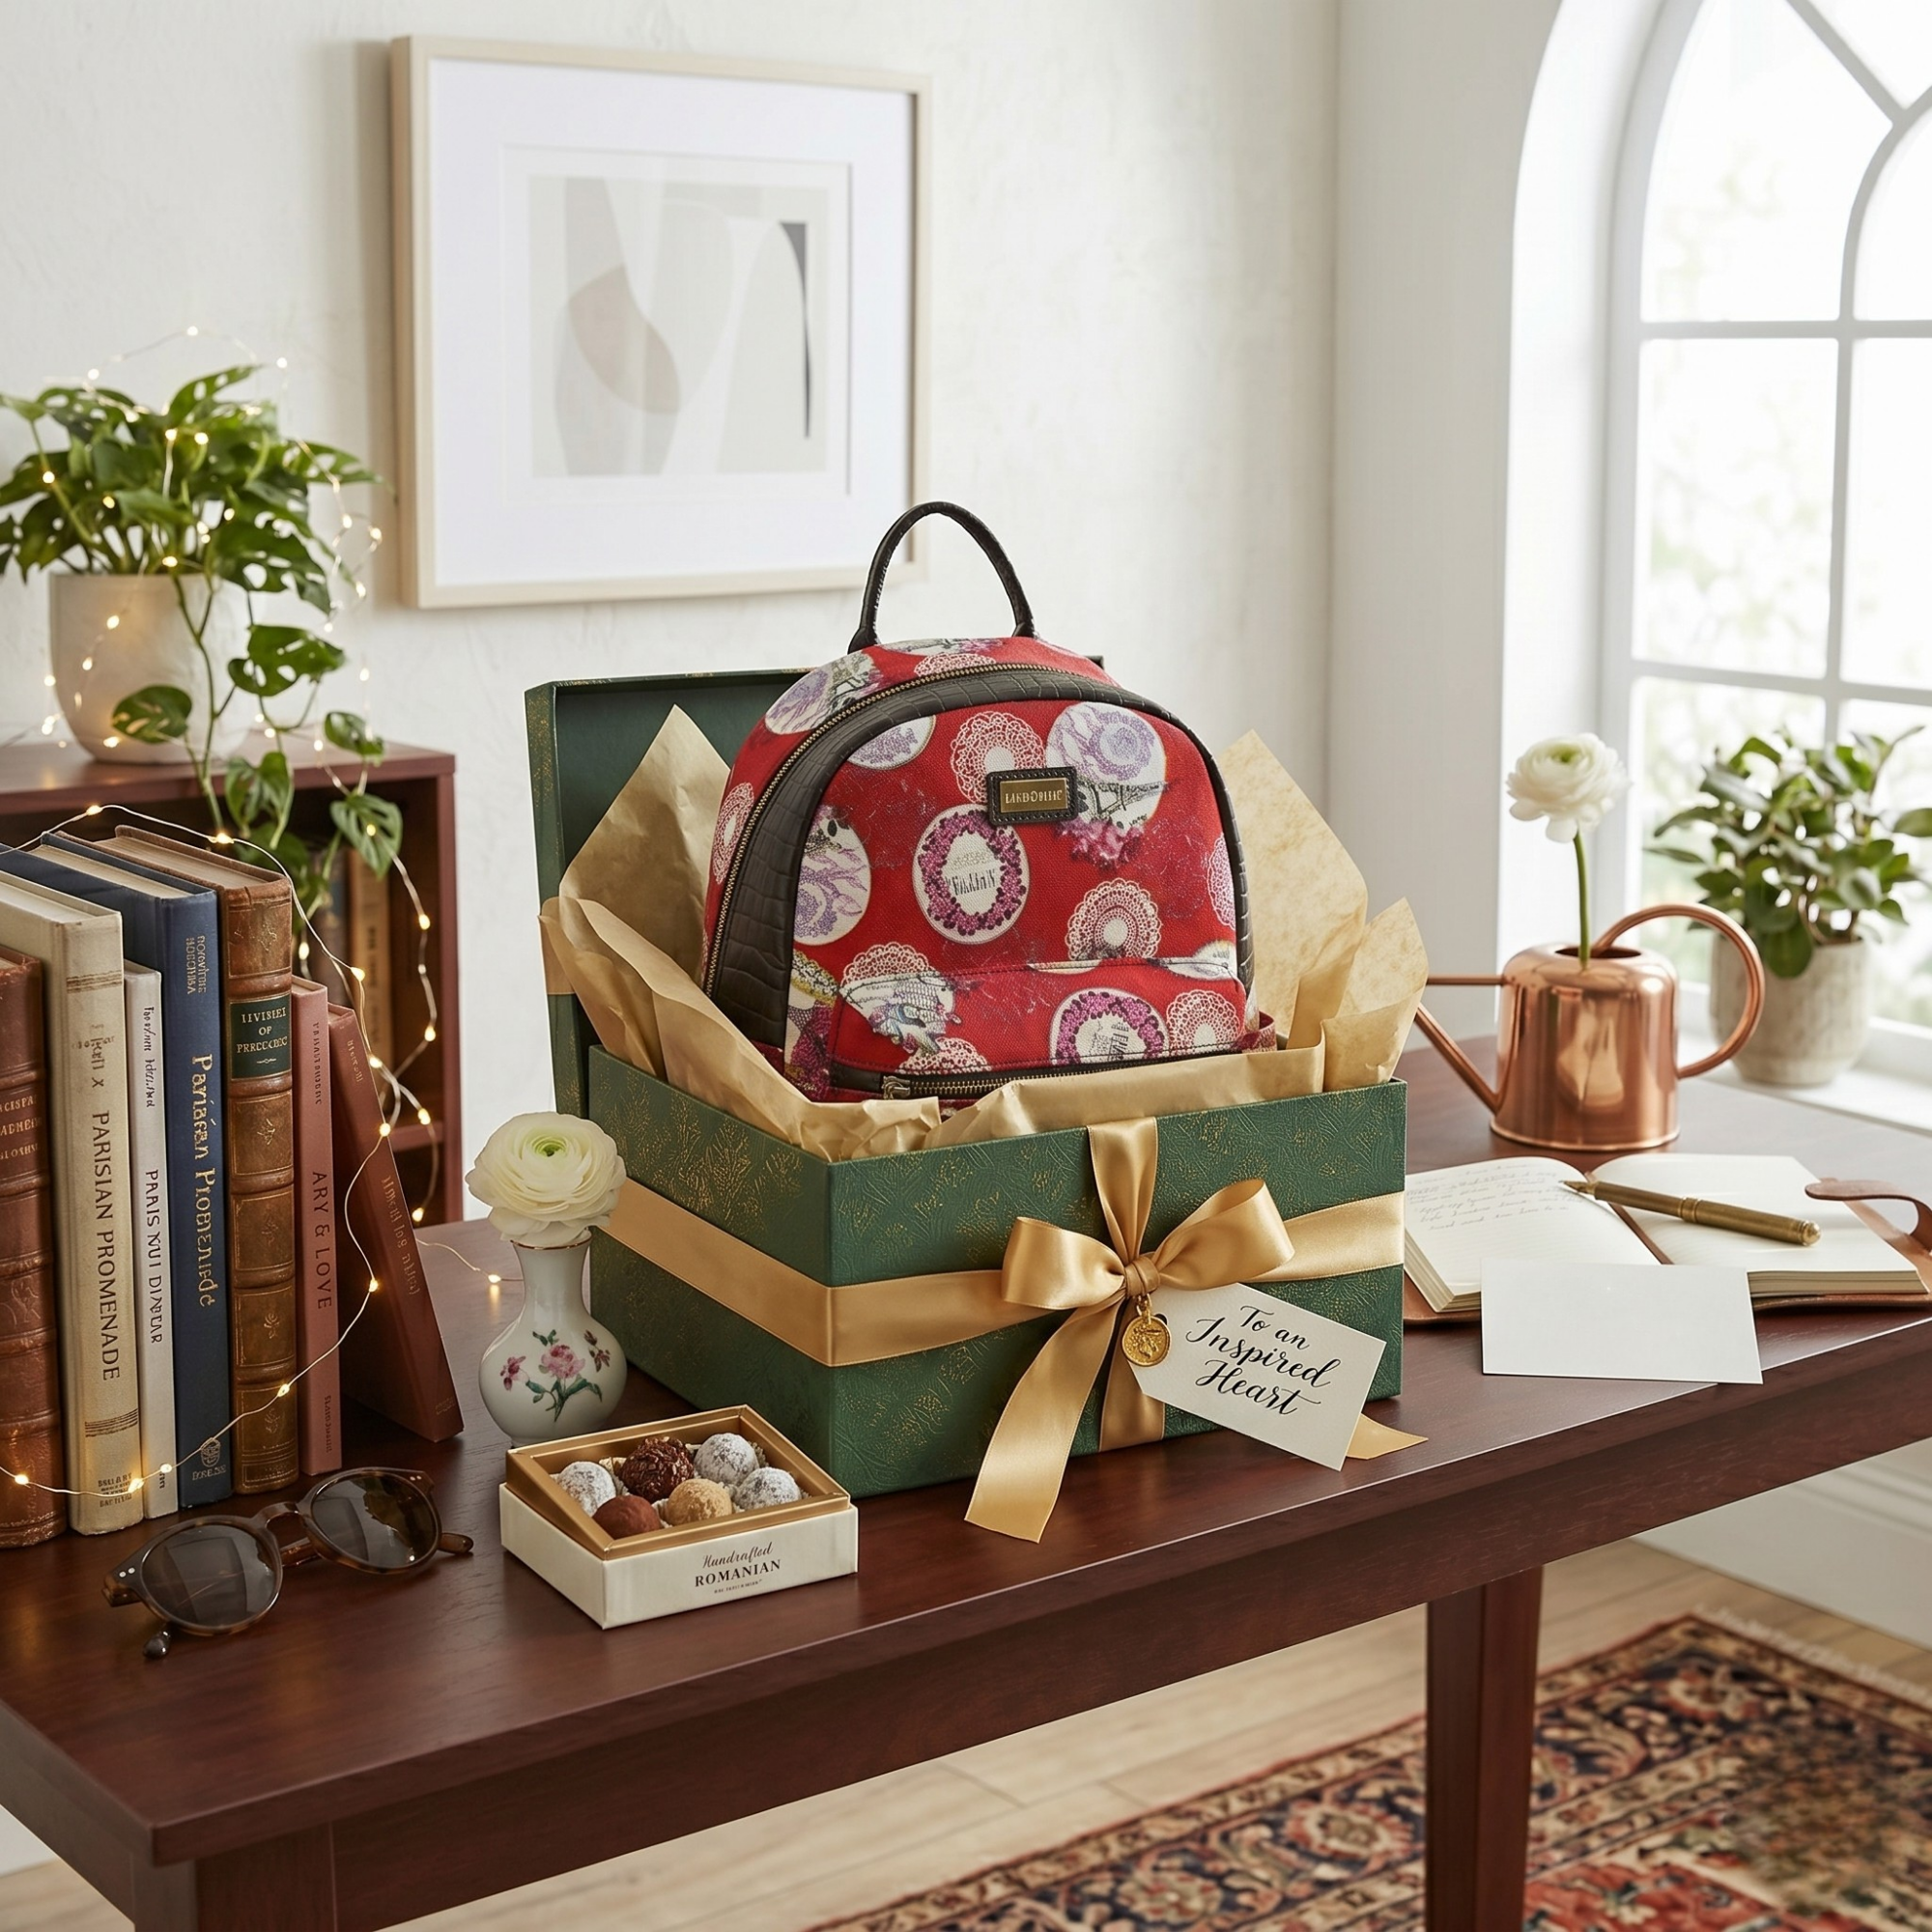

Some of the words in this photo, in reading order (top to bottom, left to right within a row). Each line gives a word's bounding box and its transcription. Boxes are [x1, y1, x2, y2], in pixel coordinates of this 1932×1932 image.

[92, 1110, 114, 1220] PARISIAN
[312, 1171, 329, 1213] ARY
[97, 1230, 121, 1381] PROMENADE
[315, 1247, 332, 1310] LOVE
[1185, 1317, 1342, 1388] Inspired
[1239, 1305, 1274, 1332] To
[1274, 1327, 1310, 1350] an
[1195, 1359, 1321, 1415] Heart
[695, 1559, 781, 1587] ROMANIAN
